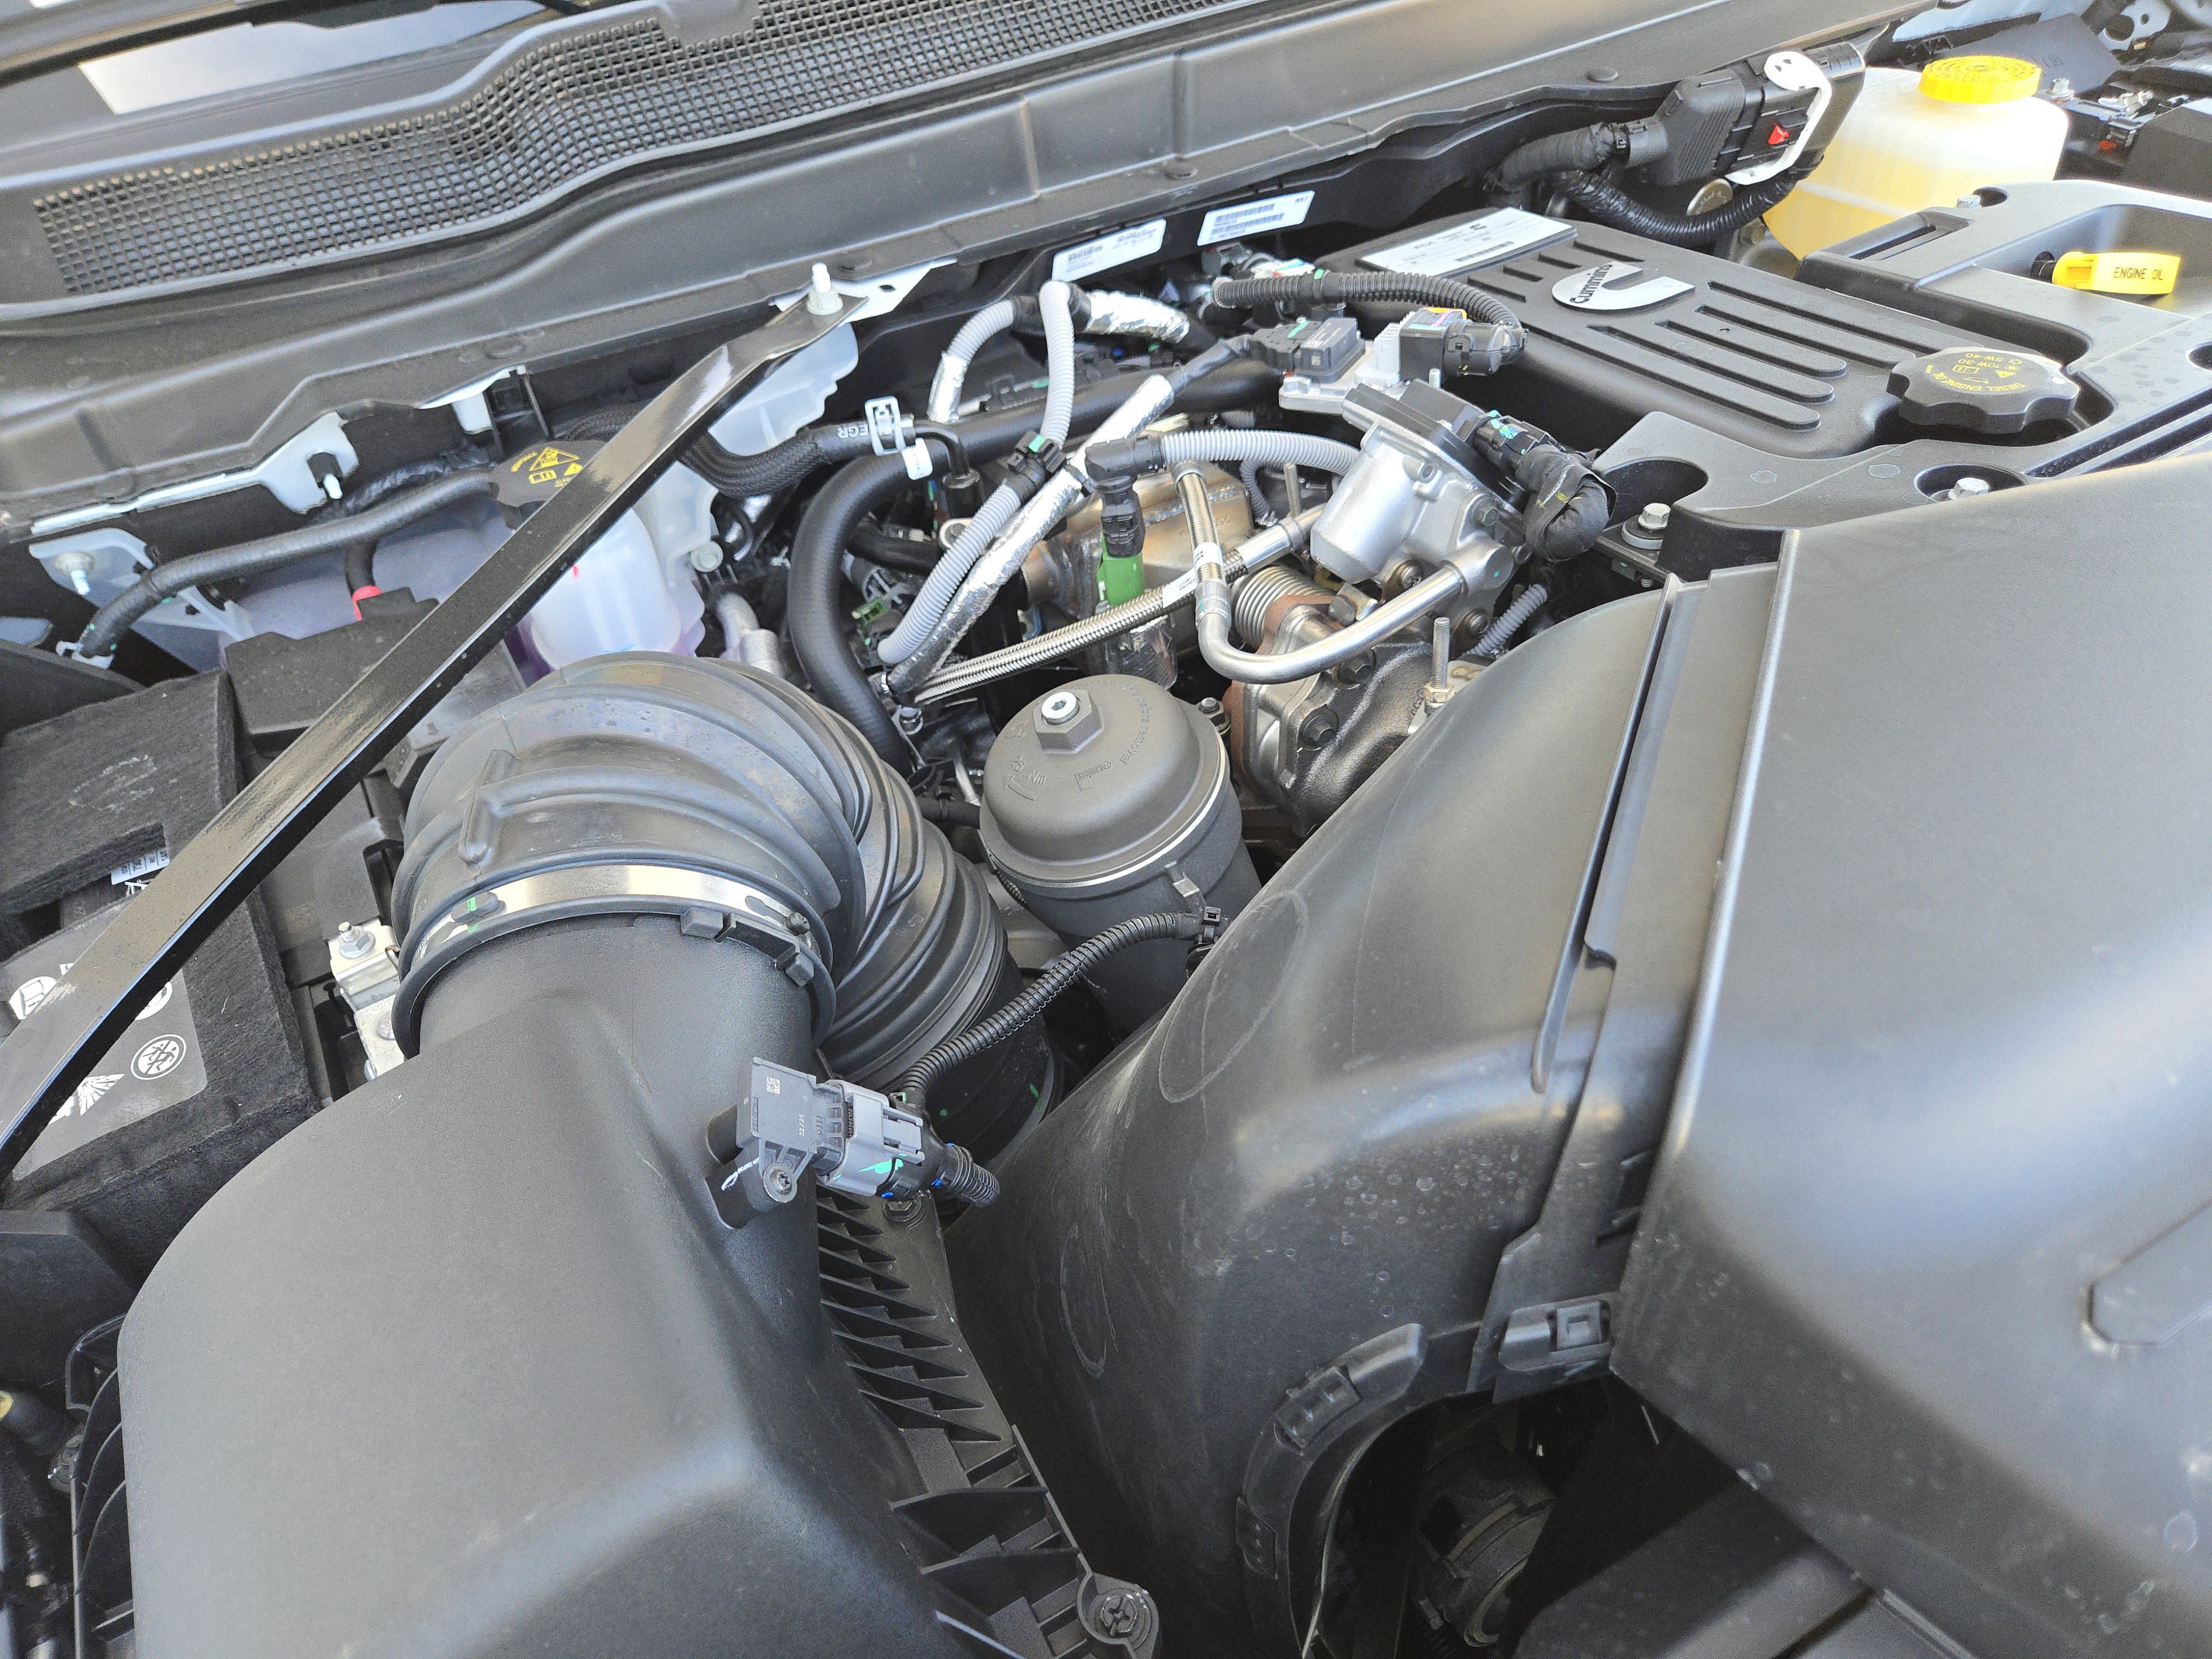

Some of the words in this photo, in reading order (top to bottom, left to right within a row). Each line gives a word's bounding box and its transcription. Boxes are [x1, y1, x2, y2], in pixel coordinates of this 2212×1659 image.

[2114, 267, 2147, 279] ENGINE
[2152, 269, 2163, 280] OIL
[1570, 264, 1613, 304] Cummins
[1957, 359, 2000, 368] 10W-30
[1965, 353, 2004, 362] 5W-40
[1932, 371, 1945, 380] OIL
[1940, 379, 1981, 392] ENGINE
[1985, 382, 2026, 392] DIESEL
[837, 422, 868, 438] EGR
[1026, 769, 1047, 785] Nm
